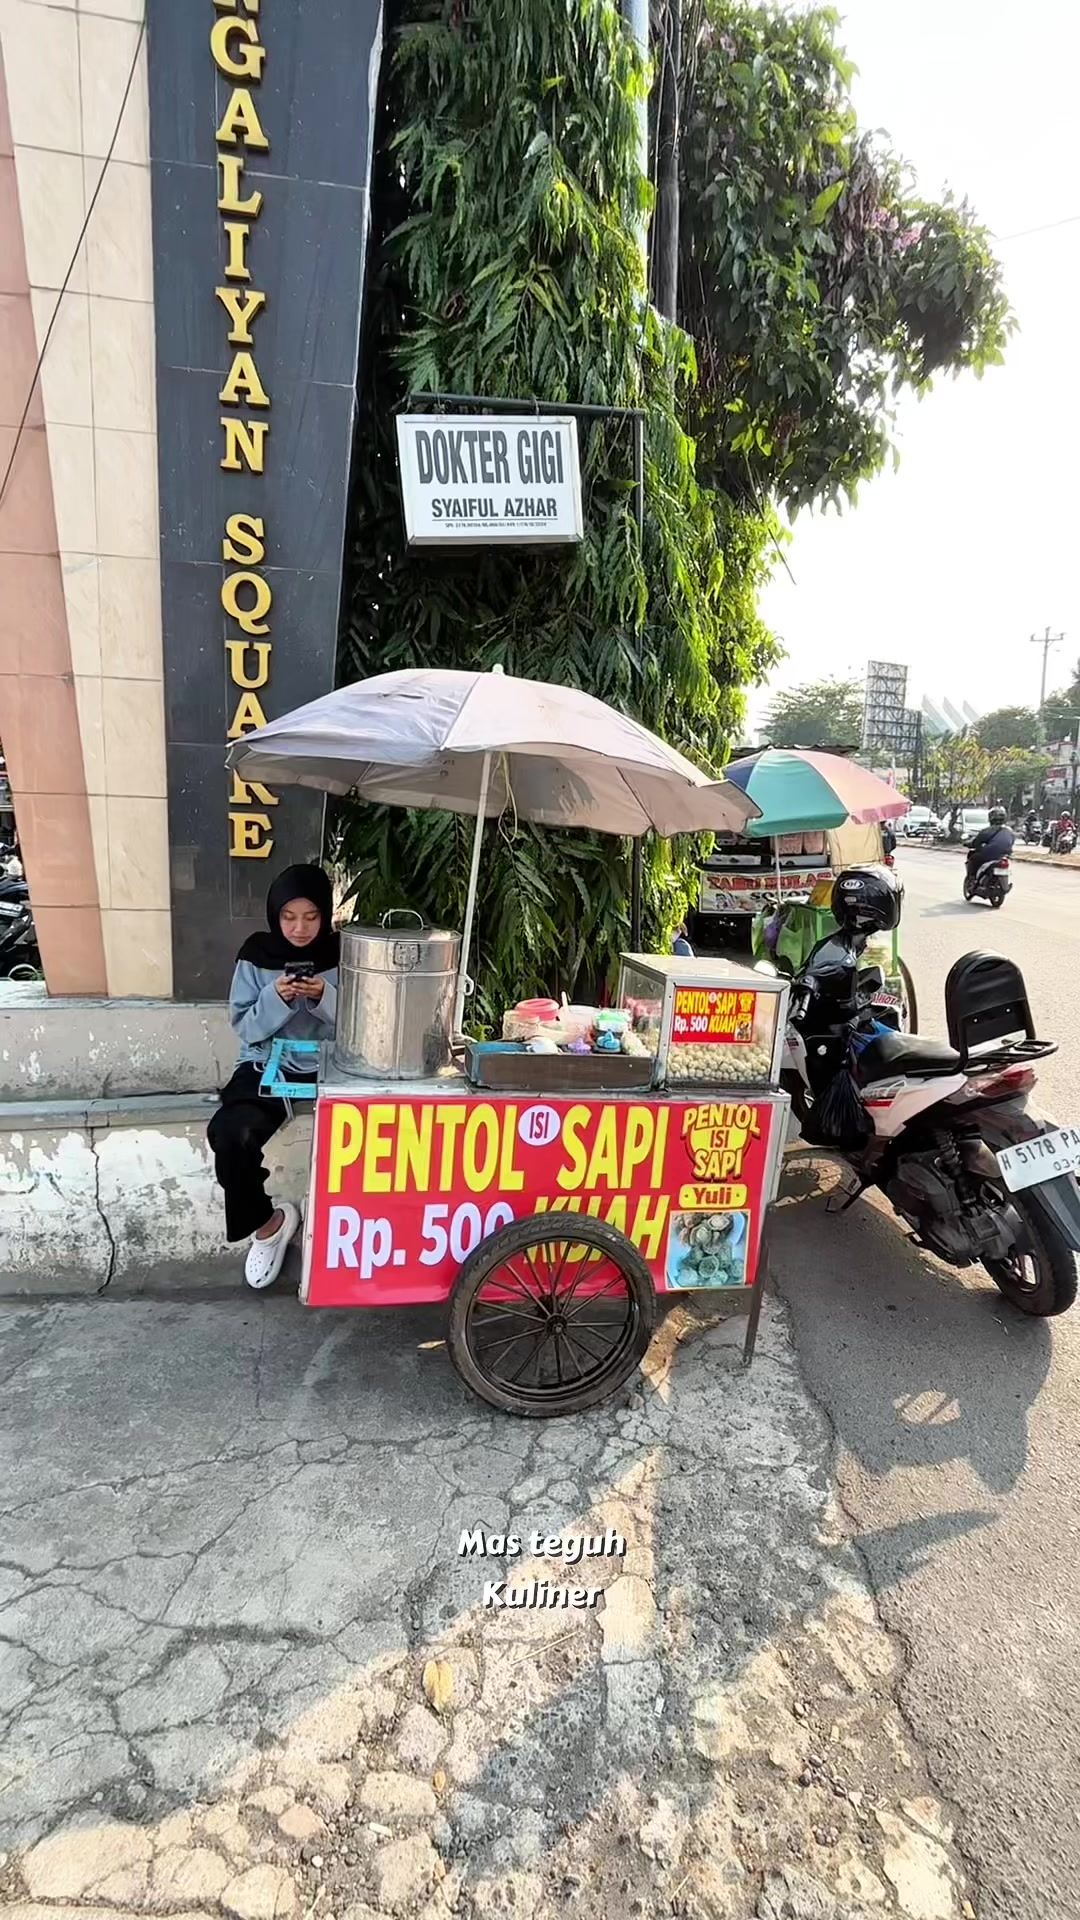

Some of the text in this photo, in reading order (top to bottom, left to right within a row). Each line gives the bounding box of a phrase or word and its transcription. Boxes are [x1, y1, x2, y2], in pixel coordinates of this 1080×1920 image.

[209, 0, 271, 474] GALIYAN
[415, 429, 564, 484] DOKTER GIGI
[431, 498, 557, 518] SYAIFUL AZHAR
[676, 991, 710, 1014] PENTOL
[716, 992, 737, 1014] SAPI
[675, 1015, 737, 1034] Rp. 500 KUAH
[682, 1103, 760, 1136] PENTOL
[327, 1103, 670, 1193] PENTOL ISI SAPI
[710, 1130, 730, 1148] ISI
[1001, 1153, 1012, 1171] H
[1015, 1138, 1056, 1164] 5178
[693, 1149, 743, 1178] SAPI
[693, 1187, 732, 1204] Yuli
[326, 1204, 406, 1279] Rp.
